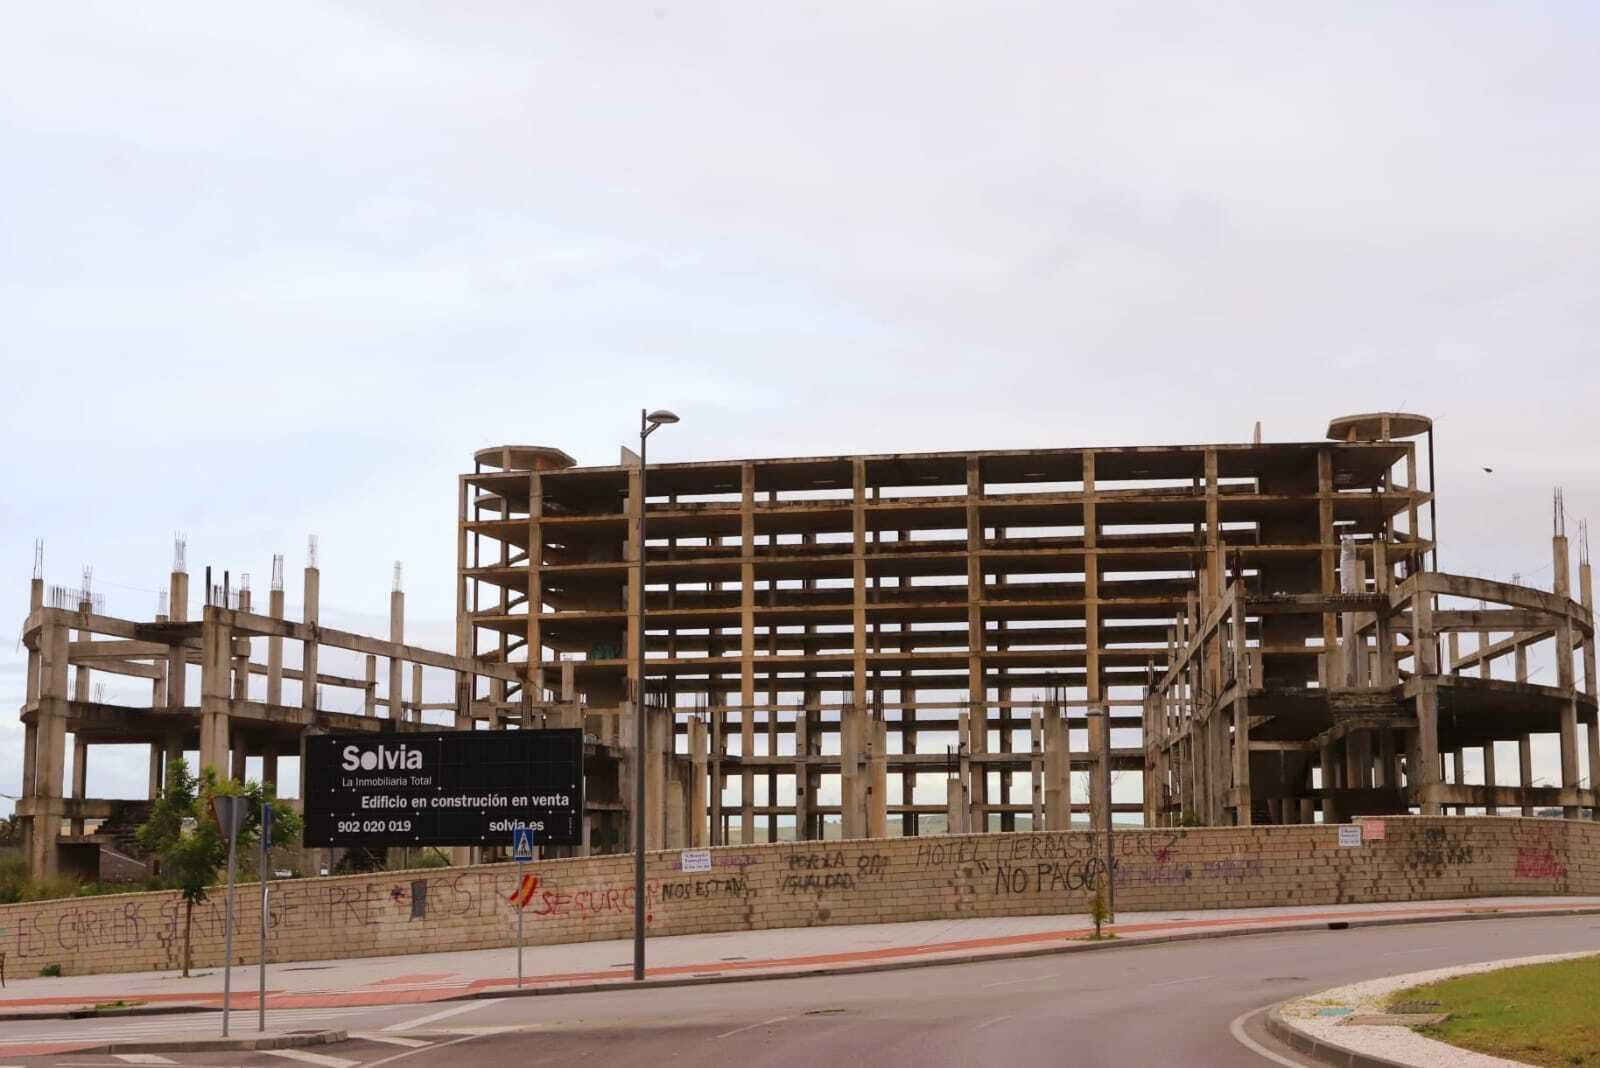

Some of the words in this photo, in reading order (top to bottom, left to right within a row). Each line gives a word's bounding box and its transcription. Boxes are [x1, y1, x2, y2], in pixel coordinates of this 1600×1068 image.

[341, 744, 423, 771] Solvia
[342, 777, 353, 787] La
[355, 777, 408, 787] Inmobiliaria
[410, 776, 432, 786] Total
[361, 794, 407, 809] Edificio
[411, 797, 427, 808] en
[431, 794, 508, 808] construción
[511, 796, 528, 807] en
[532, 793, 569, 807] venta
[337, 820, 360, 832] 902
[363, 820, 385, 832] 020
[388, 820, 411, 832] 019
